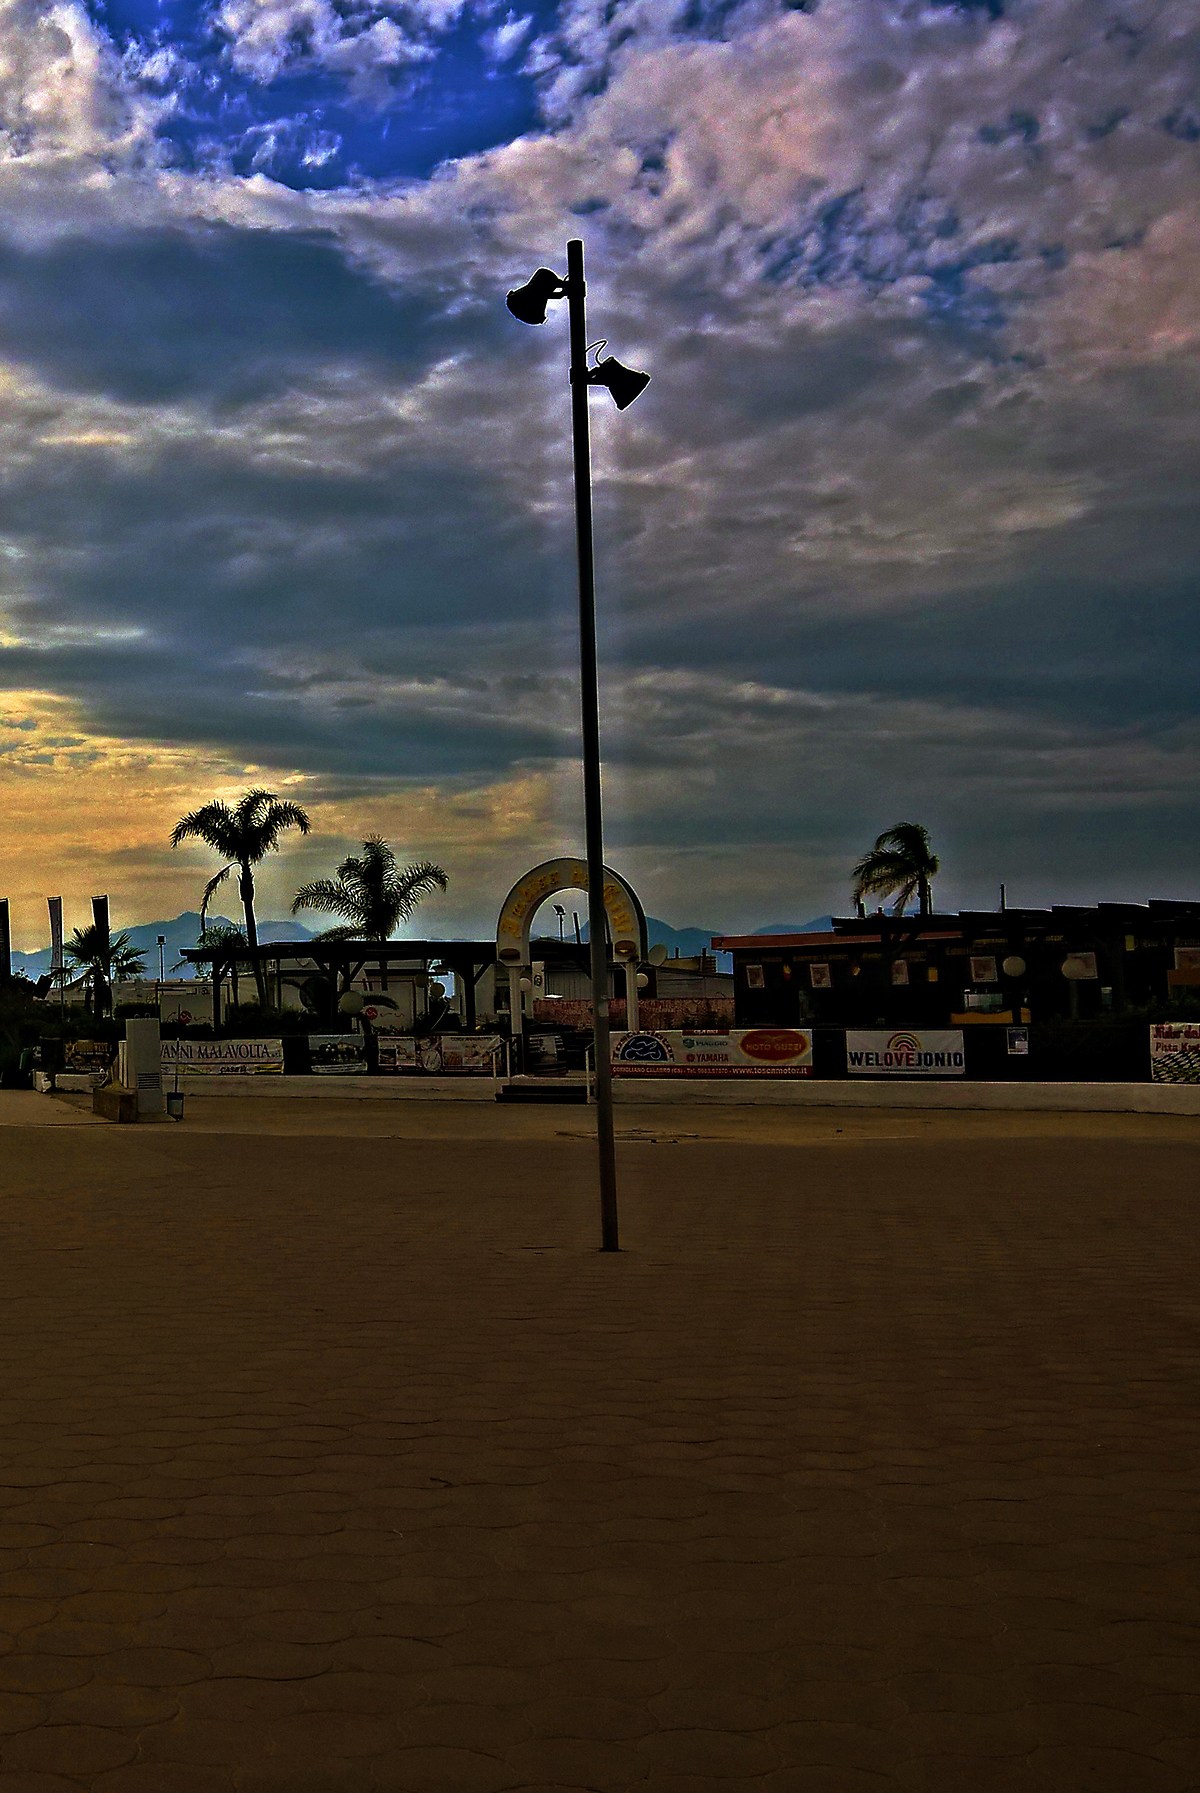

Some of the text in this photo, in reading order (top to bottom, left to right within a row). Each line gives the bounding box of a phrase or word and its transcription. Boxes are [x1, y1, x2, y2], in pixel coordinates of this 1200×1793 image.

[197, 1044, 270, 1059] MALAVOLTA
[774, 1042, 802, 1051] GUZZI
[696, 1053, 729, 1063] YAMAHA
[849, 1051, 963, 1067] WELOVEJONIO
[731, 1067, 807, 1075] www.toscamotor.it
